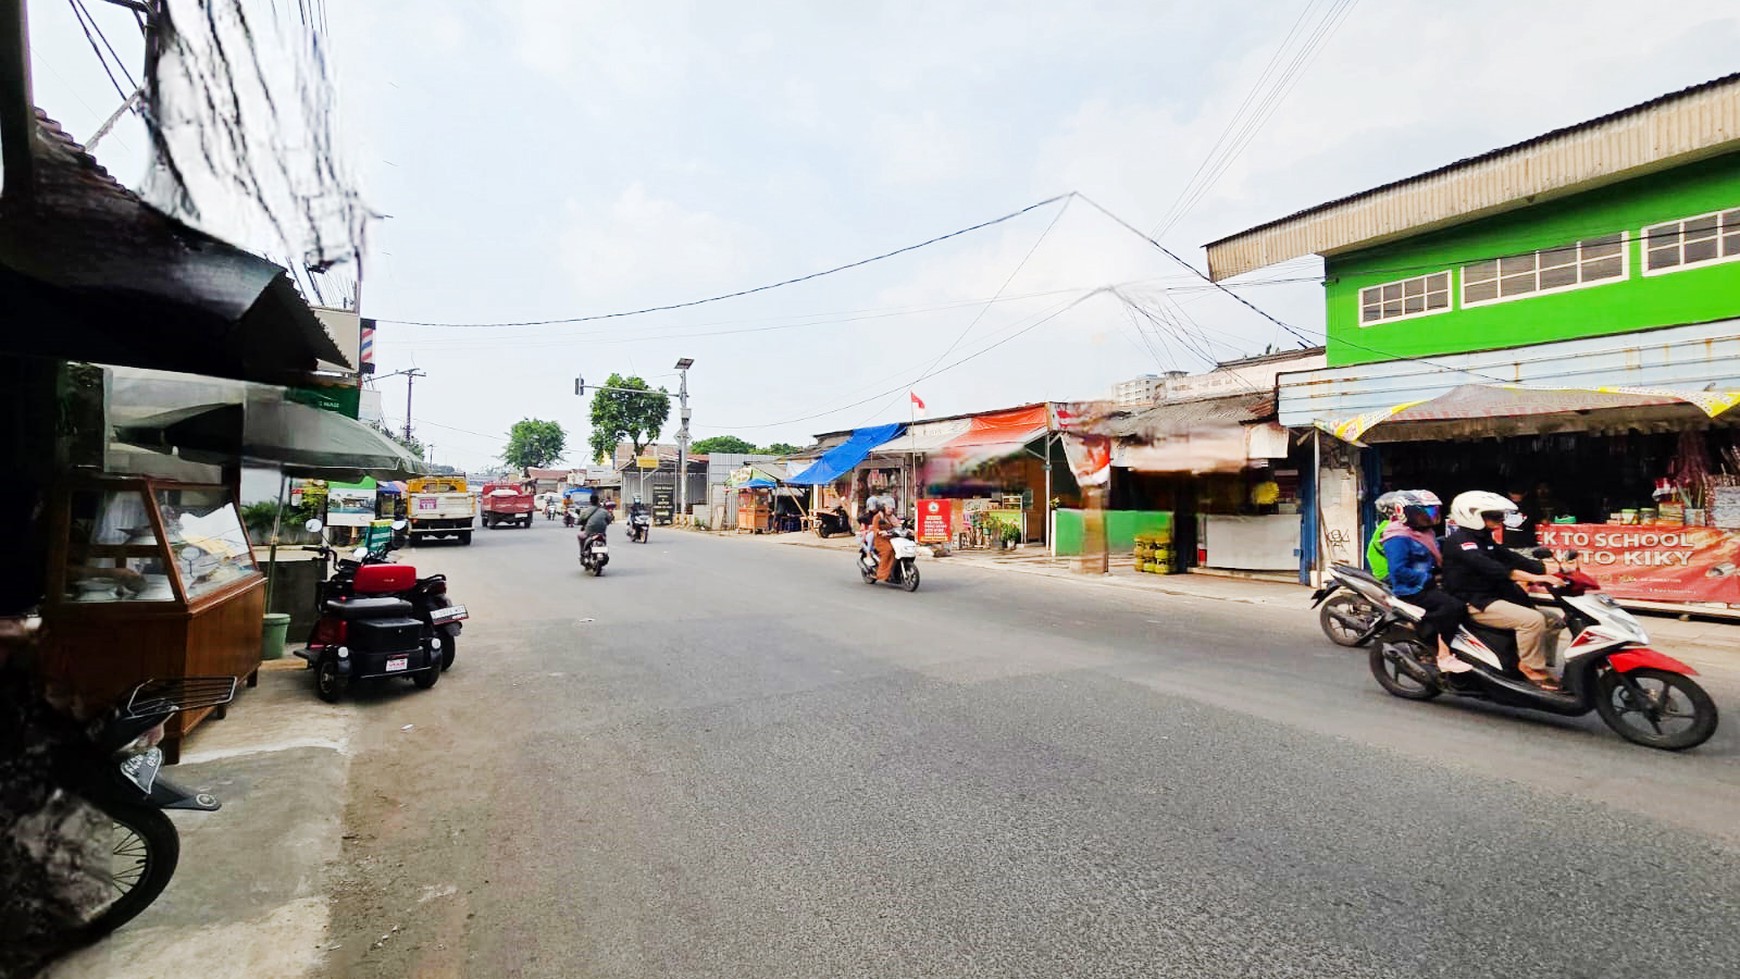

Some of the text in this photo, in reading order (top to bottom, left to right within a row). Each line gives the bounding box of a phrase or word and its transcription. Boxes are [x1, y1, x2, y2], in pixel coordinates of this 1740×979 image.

[1561, 532, 1590, 547] TO
[1594, 533, 1695, 548] SCHOOL
[1578, 550, 1616, 565] TO
[1624, 551, 1693, 567] KIKY
